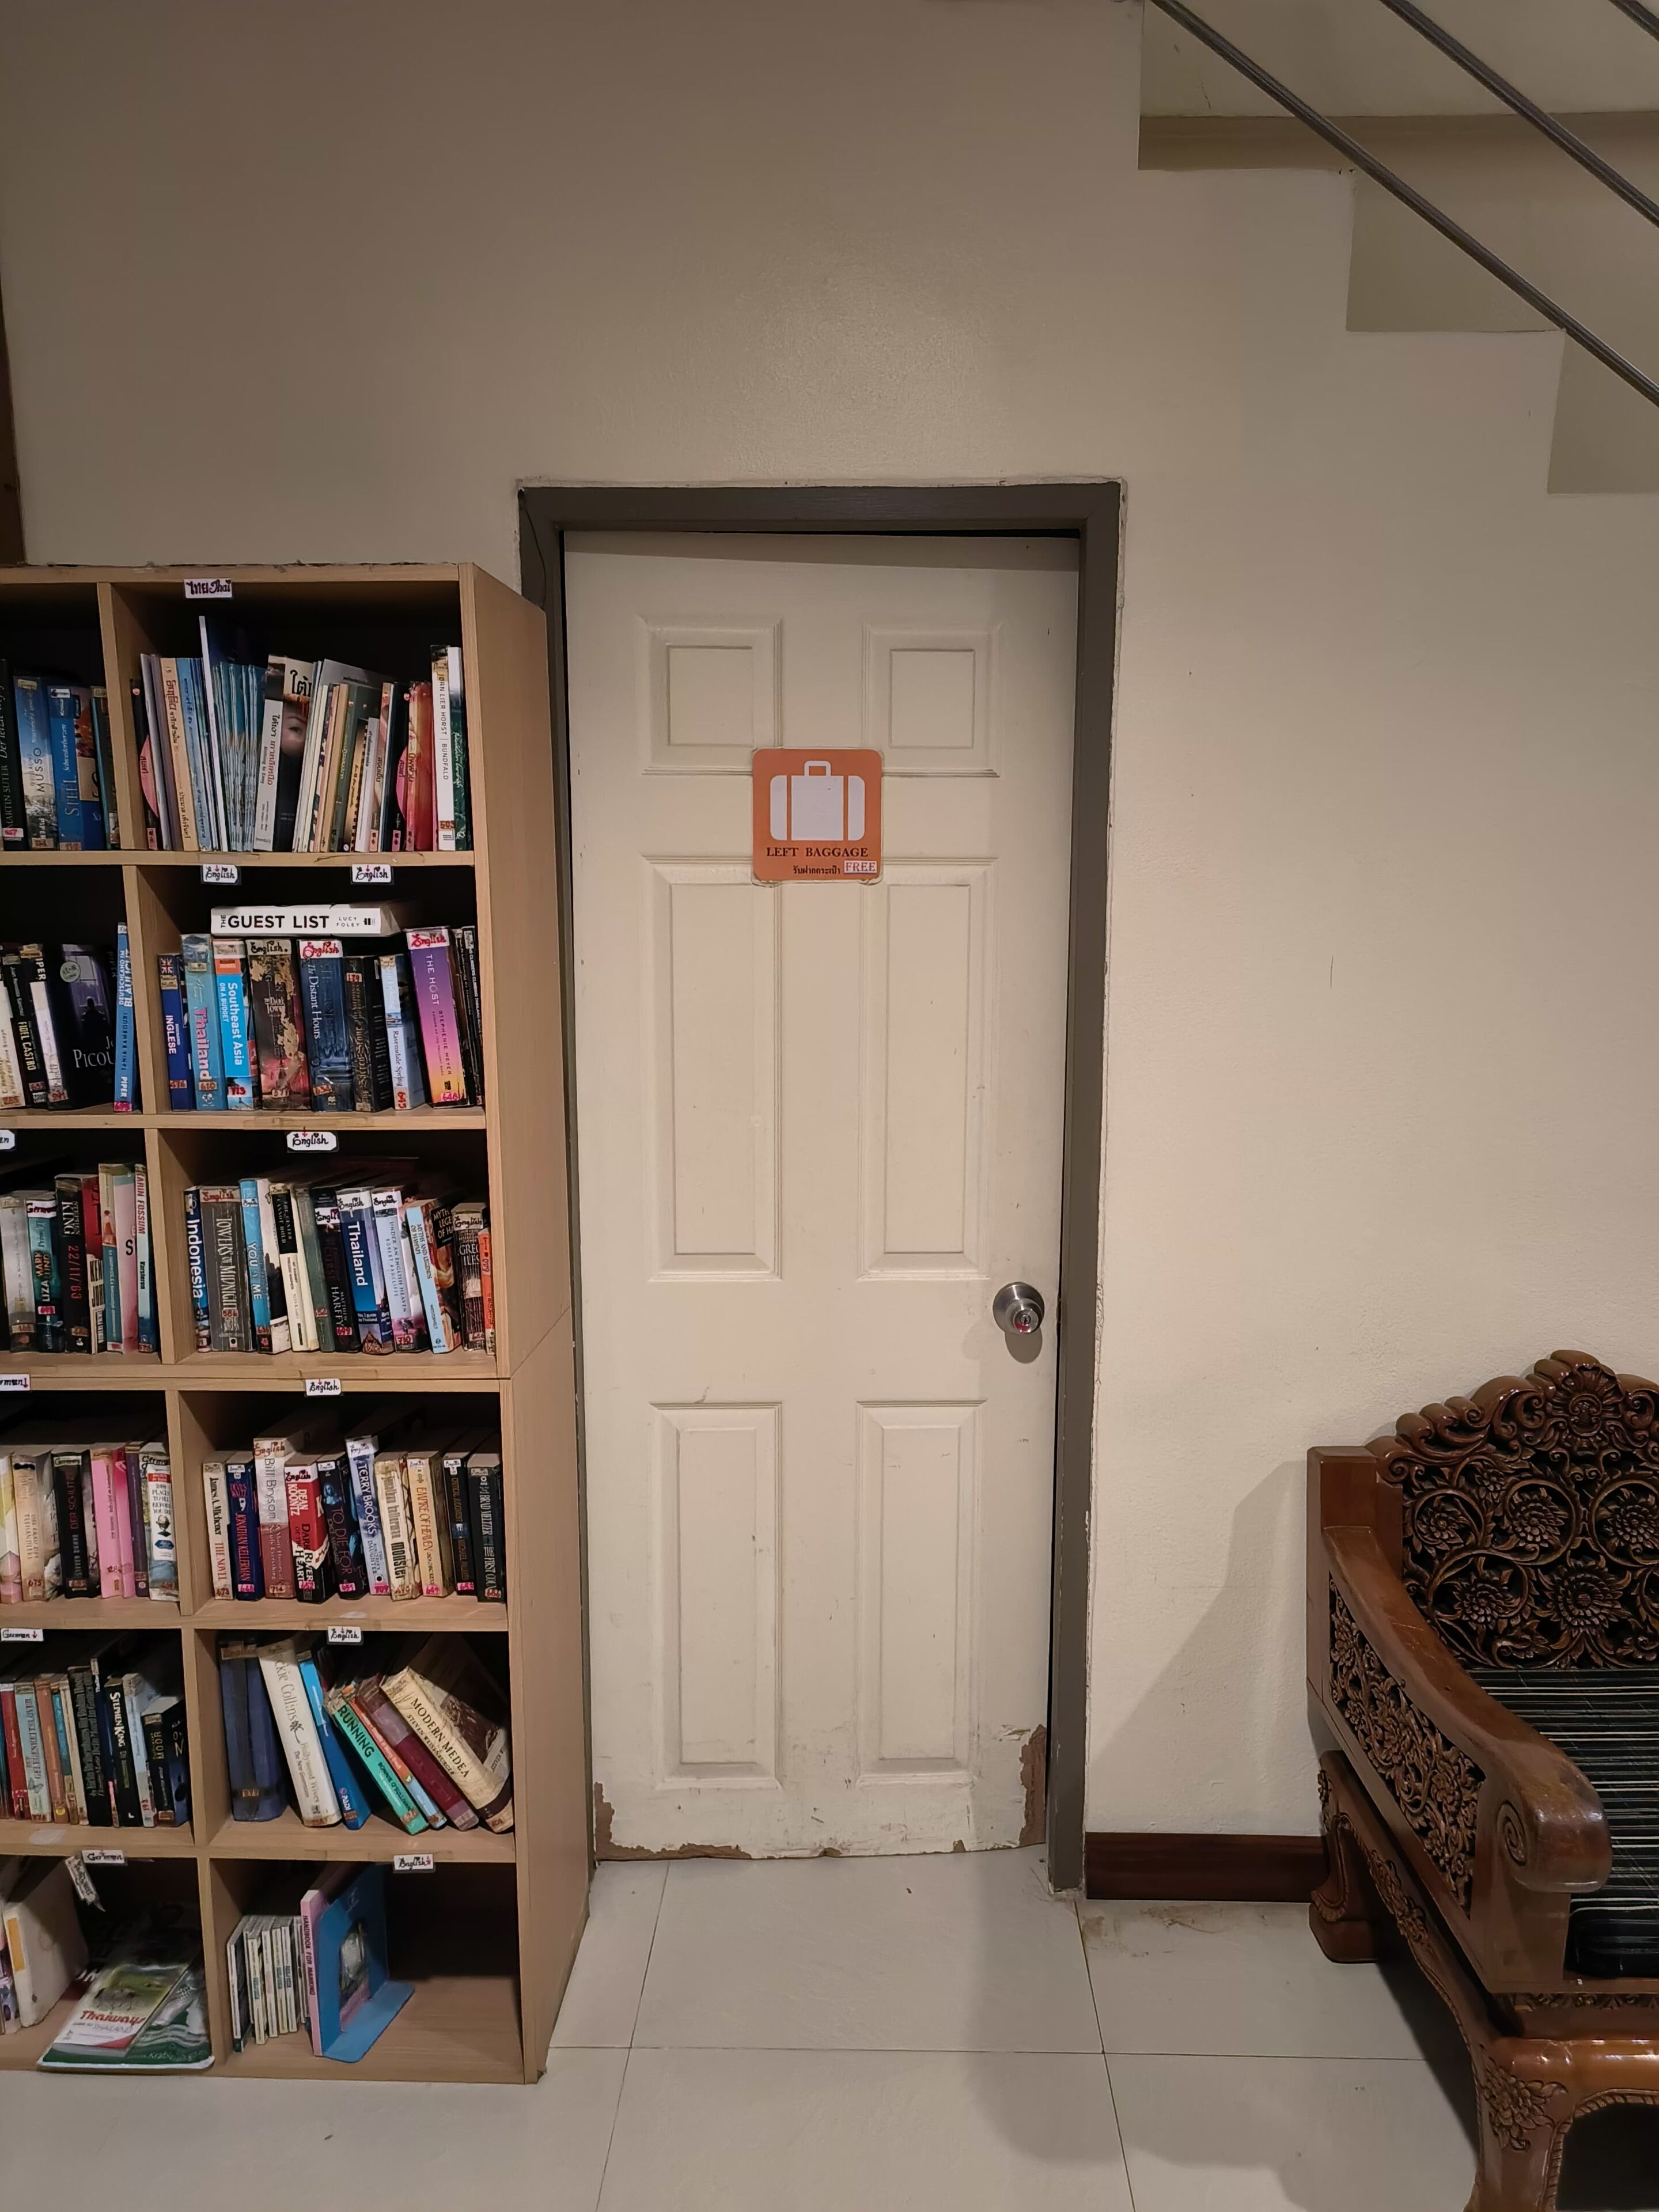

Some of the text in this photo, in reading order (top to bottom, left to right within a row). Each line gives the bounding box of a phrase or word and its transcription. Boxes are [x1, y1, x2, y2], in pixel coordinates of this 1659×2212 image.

[33, 748, 45, 792] MUSSO
[766, 847, 868, 857] LEFT BAGGAGE
[846, 862, 876, 872] FREE
[205, 867, 235, 881] English
[355, 867, 388, 881] English
[228, 915, 285, 929] GUEST
[293, 916, 329, 929] LIST
[36, 959, 46, 980] IPER
[425, 954, 440, 1005] THE HOST
[219, 983, 226, 991] ON
[308, 976, 321, 1009] Distant
[221, 999, 229, 1022] BUDGET
[228, 983, 244, 1065] Southeast Asia
[312, 1010, 322, 1039] Hours
[18, 1021, 31, 1040] FIDEL
[165, 1015, 176, 1055] INGLESE
[194, 1007, 213, 1080] Thailand
[22, 1041, 36, 1070] CASTRO
[393, 1066, 403, 1086] Spring
[292, 1134, 329, 1147] English
[136, 1172, 145, 1196] ARIN
[62, 1201, 74, 1236] KING
[216, 1217, 236, 1255] TOWERS
[187, 1219, 206, 1298] Indonesia
[348, 1221, 368, 1286] Thailand
[247, 1243, 262, 1300] YOU ME
[41, 1280, 51, 1302] LIZA
[331, 1286, 344, 1327] HARFFY
[309, 1380, 339, 1393] English
[264, 1459, 277, 1519] Bill Bryson
[288, 1484, 300, 1516] KOONTZ
[298, 1489, 308, 1510] DEAN
[357, 1464, 376, 1535] TERRY BROOKS
[416, 1487, 427, 1512] EMPIRE
[236, 1513, 248, 1544] JONATHAN
[421, 1514, 429, 1522] OF
[480, 1495, 493, 1535] BRAD MELTZER
[302, 1524, 313, 1581] DARK RIVER
[332, 1506, 352, 1574] TO DIE FOR
[421, 1525, 433, 1551] HEAVEN
[238, 1546, 249, 1581] KELLERMAN
[296, 1551, 304, 1581] HEART
[391, 1542, 406, 1580] monster
[484, 1557, 496, 1573] FIRST
[281, 1684, 297, 1721] Collins
[109, 1692, 127, 1747] STEPHEN KING
[338, 1705, 375, 1758] RUNNING
[154, 1731, 165, 1759] MOOR
[411, 1698, 469, 1778] MODERN MEDEA
[302, 1915, 311, 1948] HANDBOOK
[80, 2010, 146, 2025] Thaiways
